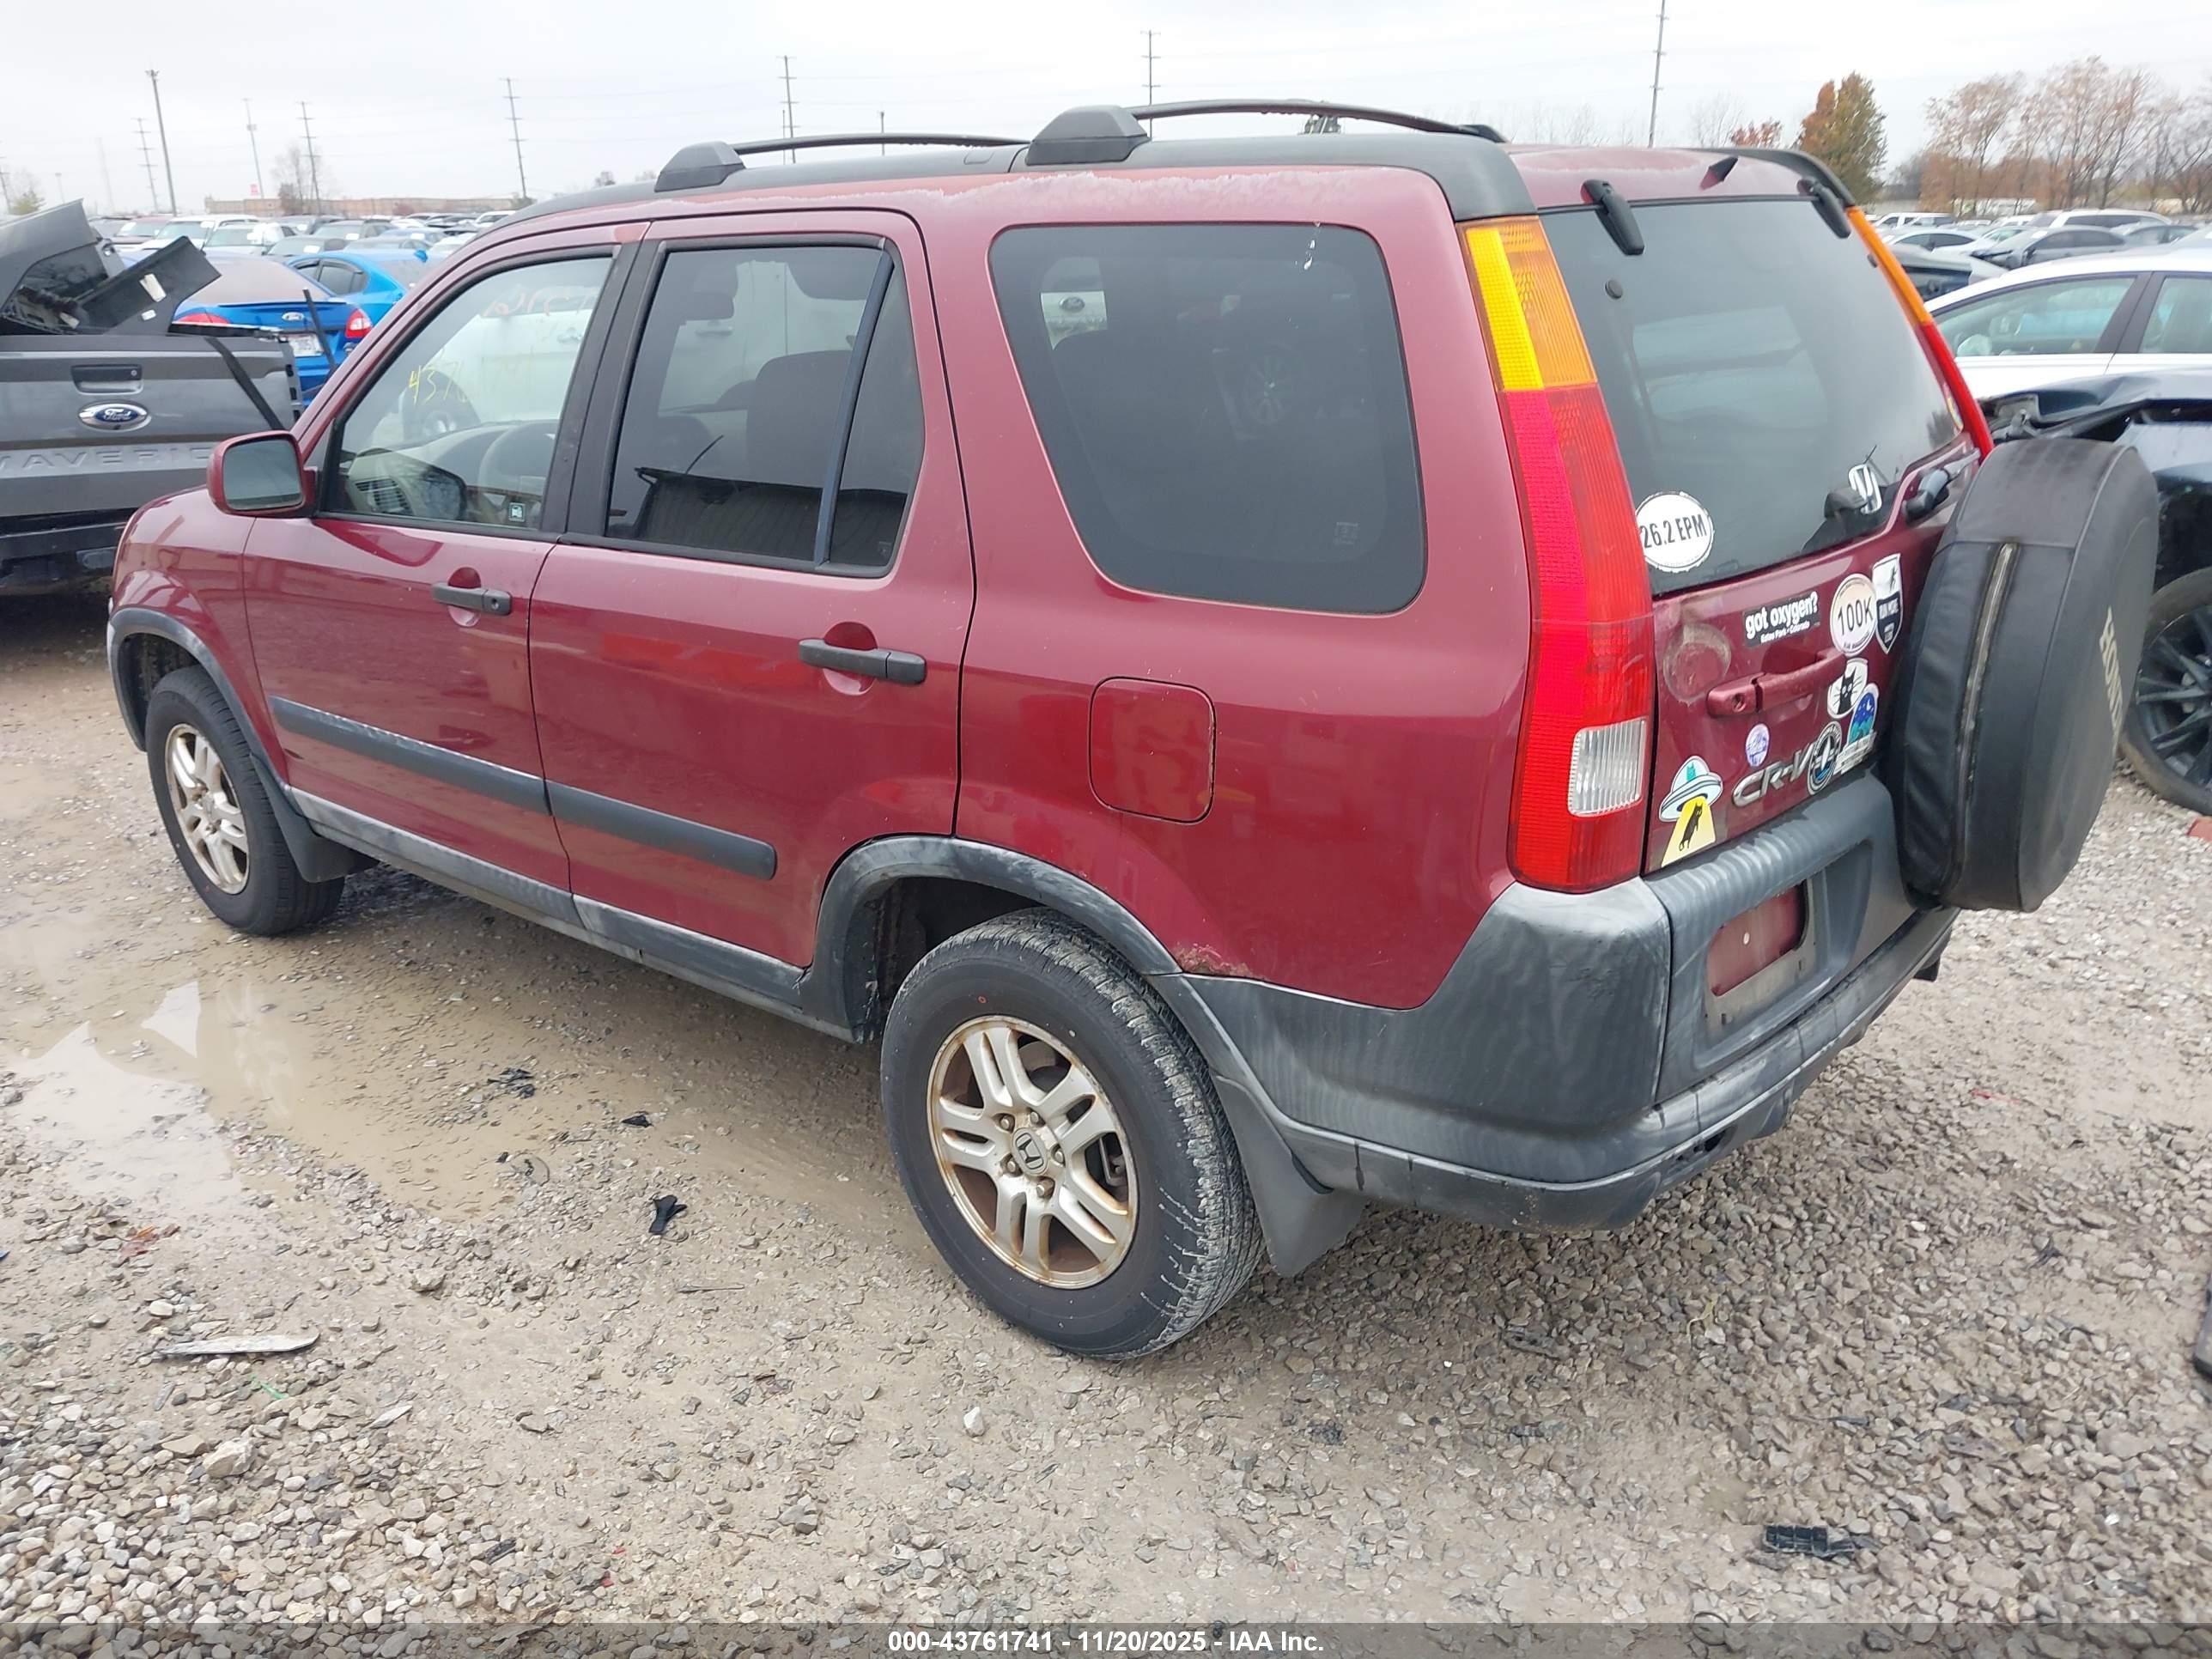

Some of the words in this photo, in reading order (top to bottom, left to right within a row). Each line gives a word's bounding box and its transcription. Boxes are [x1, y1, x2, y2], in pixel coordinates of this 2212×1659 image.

[102, 407, 134, 422] Ford
[0, 445, 212, 471] AVERIC
[1635, 520, 1675, 549] 26.2
[1674, 513, 1707, 541] EPM
[1745, 606, 1769, 640] got
[1770, 591, 1819, 628] oxygen?
[1838, 596, 1874, 635] 100K
[1731, 742, 1815, 807] CR-V
